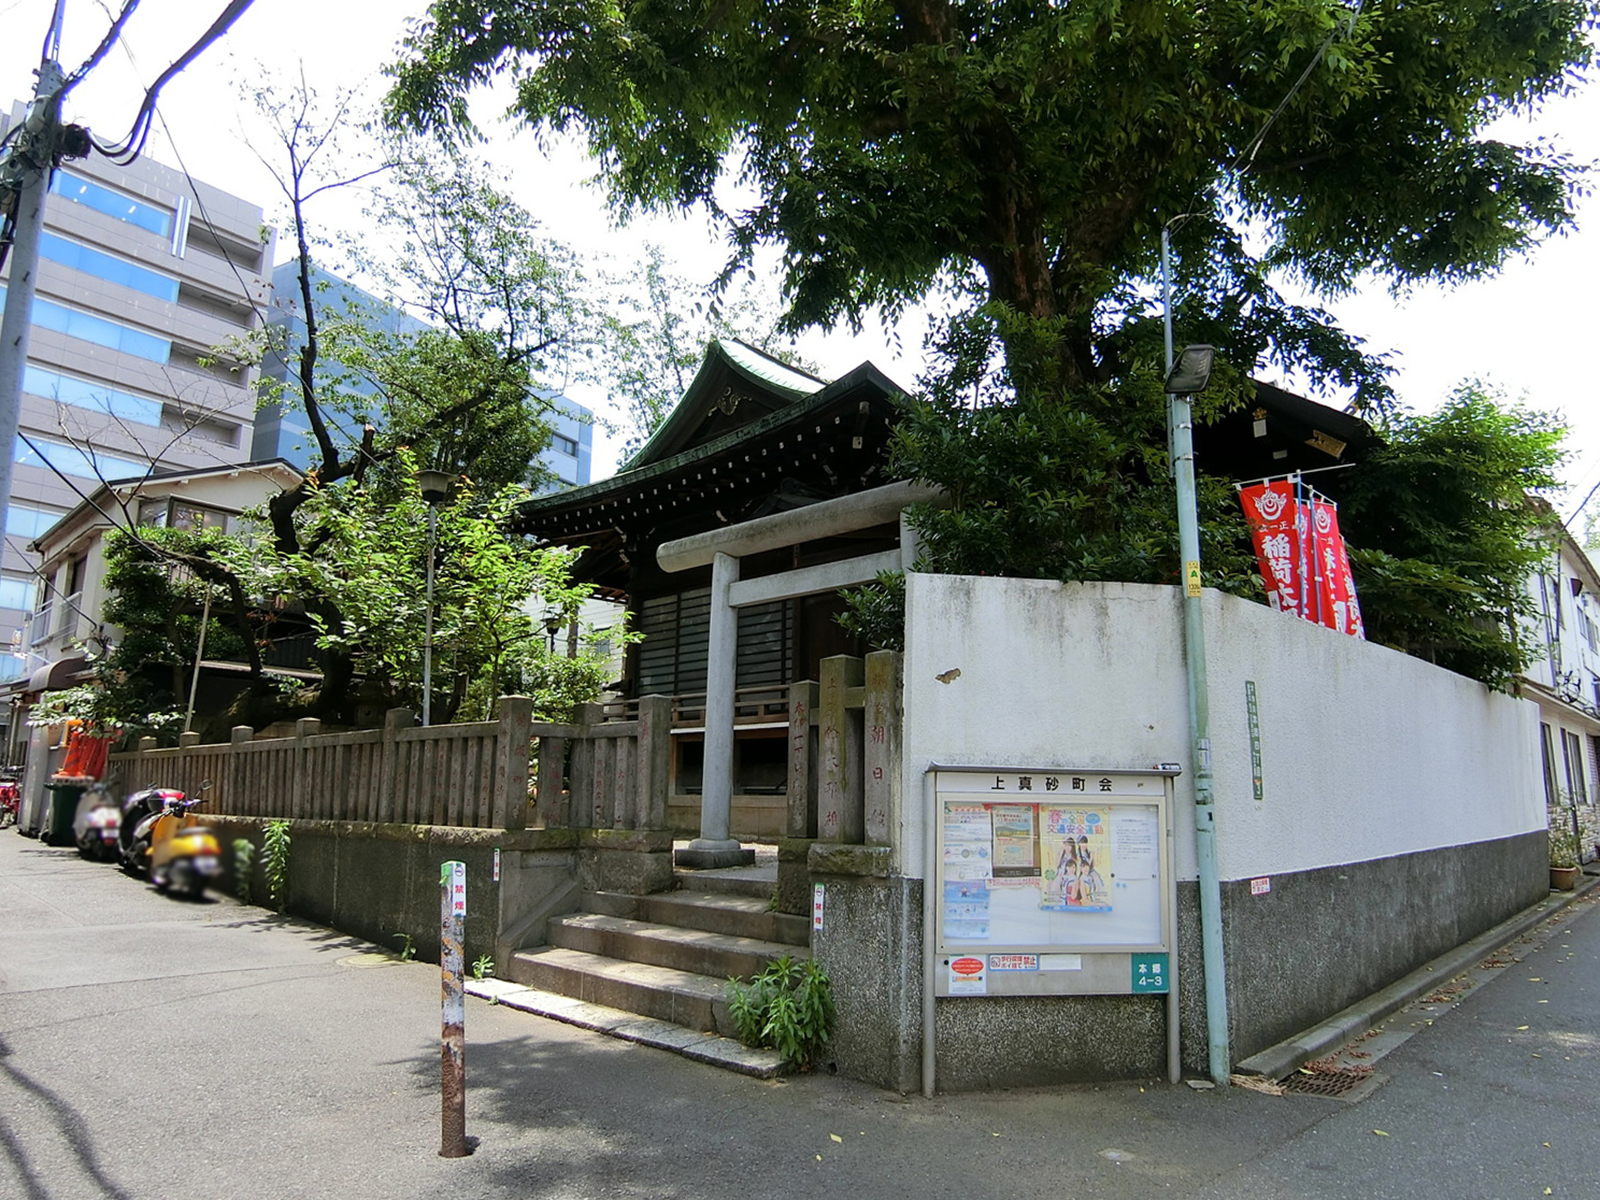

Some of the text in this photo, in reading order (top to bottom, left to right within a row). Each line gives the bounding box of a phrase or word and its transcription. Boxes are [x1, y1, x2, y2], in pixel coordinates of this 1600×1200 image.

[991, 776, 1112, 792] 上真砂町会
[1049, 809, 1085, 824] 春の全国
[1047, 824, 1103, 834] 交通安全運動
[455, 885, 464, 910] 禁煙
[1024, 956, 1036, 965] 禁止
[1138, 963, 1161, 974] 本郷
[1138, 976, 1162, 986] 4-3
